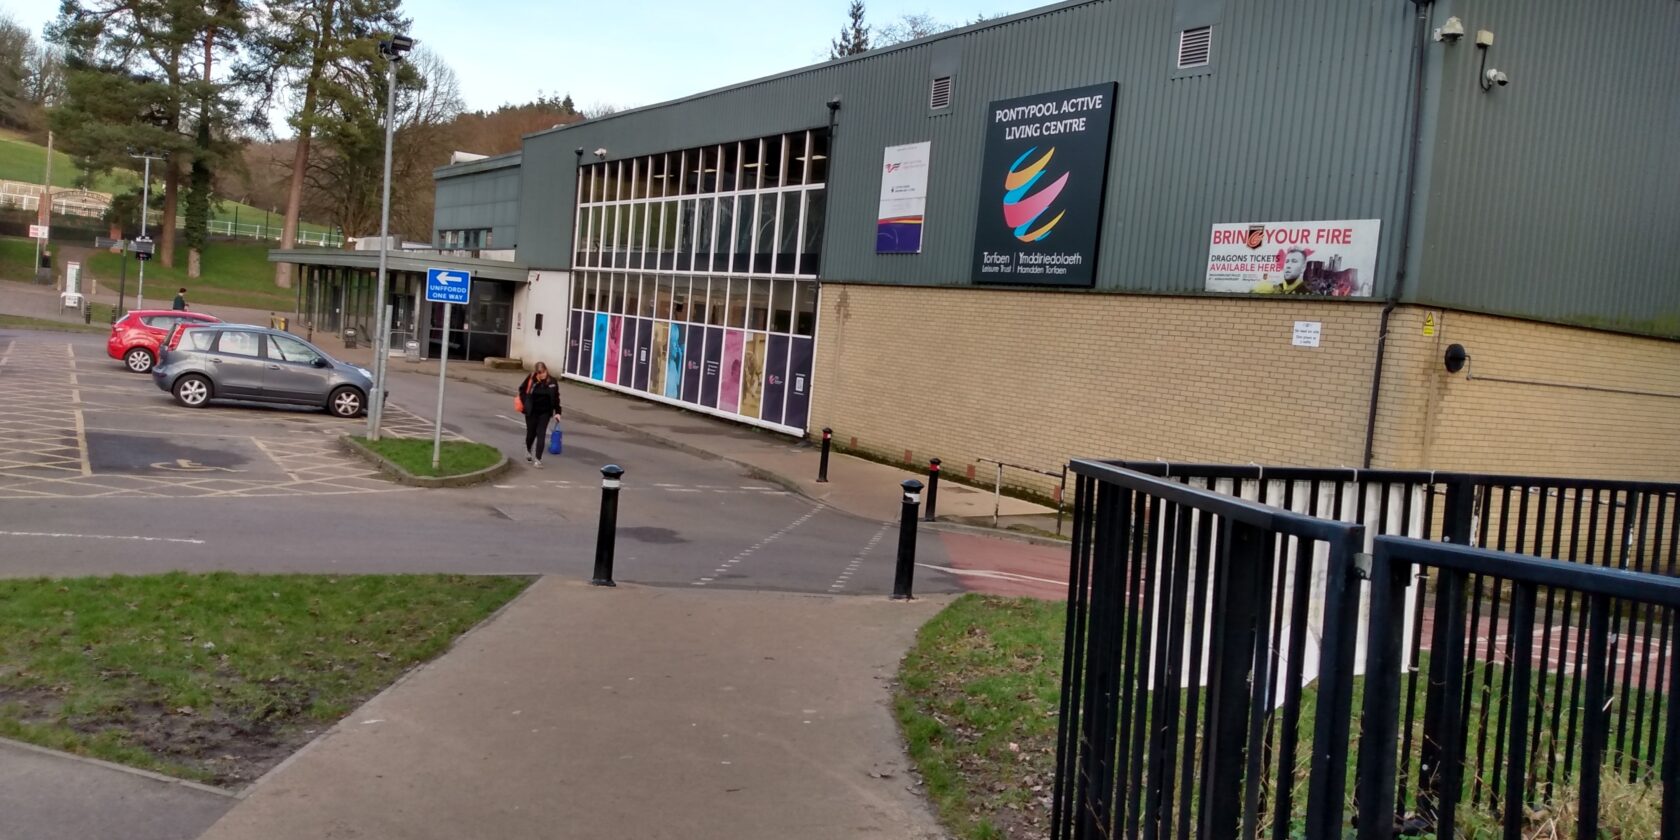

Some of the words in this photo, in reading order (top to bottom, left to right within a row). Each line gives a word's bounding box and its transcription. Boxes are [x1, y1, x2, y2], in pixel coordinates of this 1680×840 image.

[995, 103, 1058, 123] PONTYPOOL
[1060, 94, 1103, 114] ACTIVE
[1005, 123, 1040, 140] LIVING
[1042, 117, 1086, 136] CENTRE
[1265, 228, 1310, 245] YOUR
[1315, 228, 1353, 245] FIRE
[983, 252, 1010, 264] Torfaen
[1019, 252, 1082, 265] Ymddiriedolaeth
[1210, 254, 1247, 263] DRAGONS
[1249, 254, 1280, 263] TICKETS
[1045, 265, 1067, 275] Torfaen
[1210, 263, 1255, 272] AVAILABLE
[1257, 263, 1281, 272] HERE
[430, 285, 467, 293] UNFFORDD
